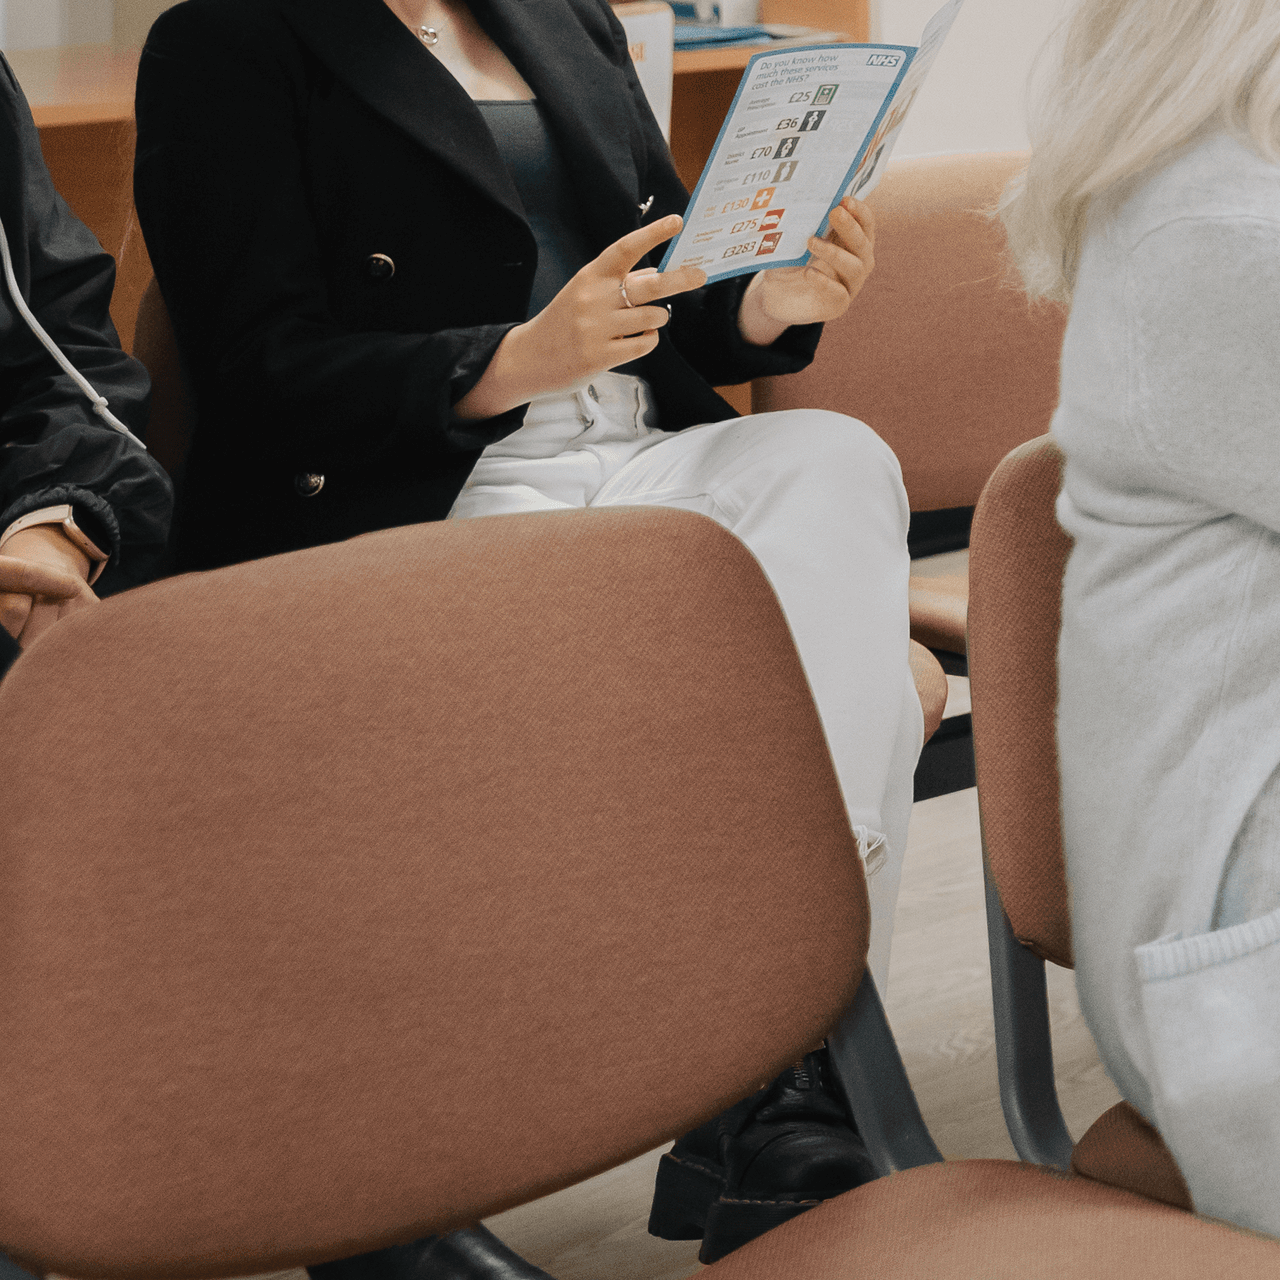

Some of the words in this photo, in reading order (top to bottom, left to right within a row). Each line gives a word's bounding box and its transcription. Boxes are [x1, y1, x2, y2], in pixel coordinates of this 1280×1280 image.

[760, 62, 772, 71] Do
[774, 59, 790, 71] you
[791, 55, 817, 65] know
[818, 54, 839, 63] how
[868, 55, 900, 67] NHS
[755, 68, 778, 80] much
[780, 66, 805, 76] these
[805, 63, 839, 73] services
[752, 80, 769, 90] cost
[770, 77, 784, 87] the
[784, 74, 810, 85] NHS?
[788, 91, 812, 104] £25
[775, 118, 799, 131] £36
[750, 146, 772, 160] £70
[742, 170, 771, 185] £110
[721, 198, 749, 214] £130
[730, 218, 759, 234] £275
[721, 241, 757, 259] £3283
